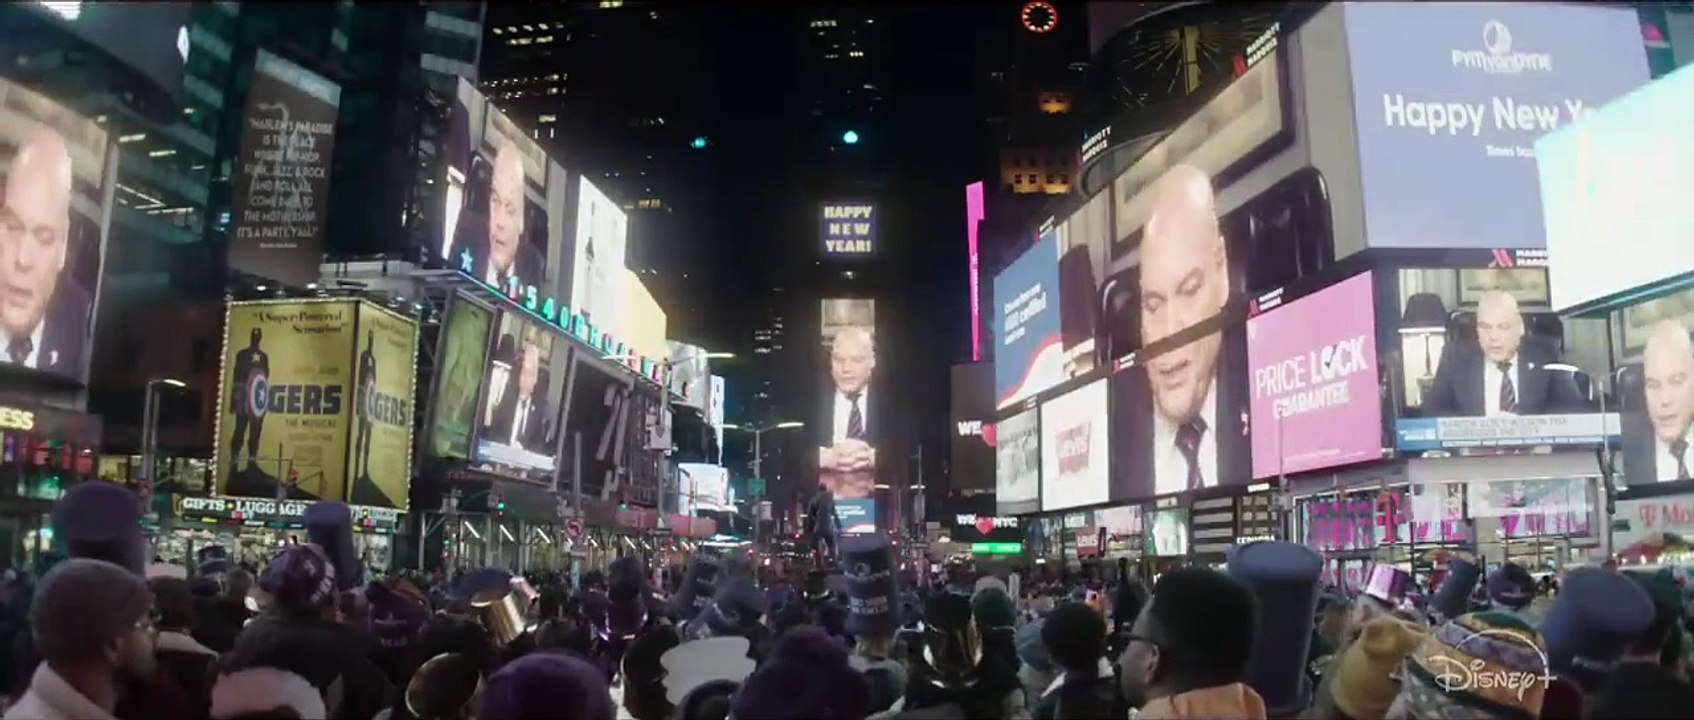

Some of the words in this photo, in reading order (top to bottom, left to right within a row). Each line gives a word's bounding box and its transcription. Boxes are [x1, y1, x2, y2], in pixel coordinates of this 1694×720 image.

[1383, 94, 1485, 136] Happy
[1493, 96, 1560, 133] New
[824, 205, 873, 219] HAPPY
[825, 239, 872, 253] YEAR!
[1255, 354, 1310, 400] PRICE
[1309, 334, 1368, 385] LOCK
[1272, 380, 1351, 420] GUARANTEE
[957, 420, 983, 437] WE
[183, 497, 226, 511] GIFTS
[956, 513, 977, 526] WE
[994, 516, 1018, 529] NYC
